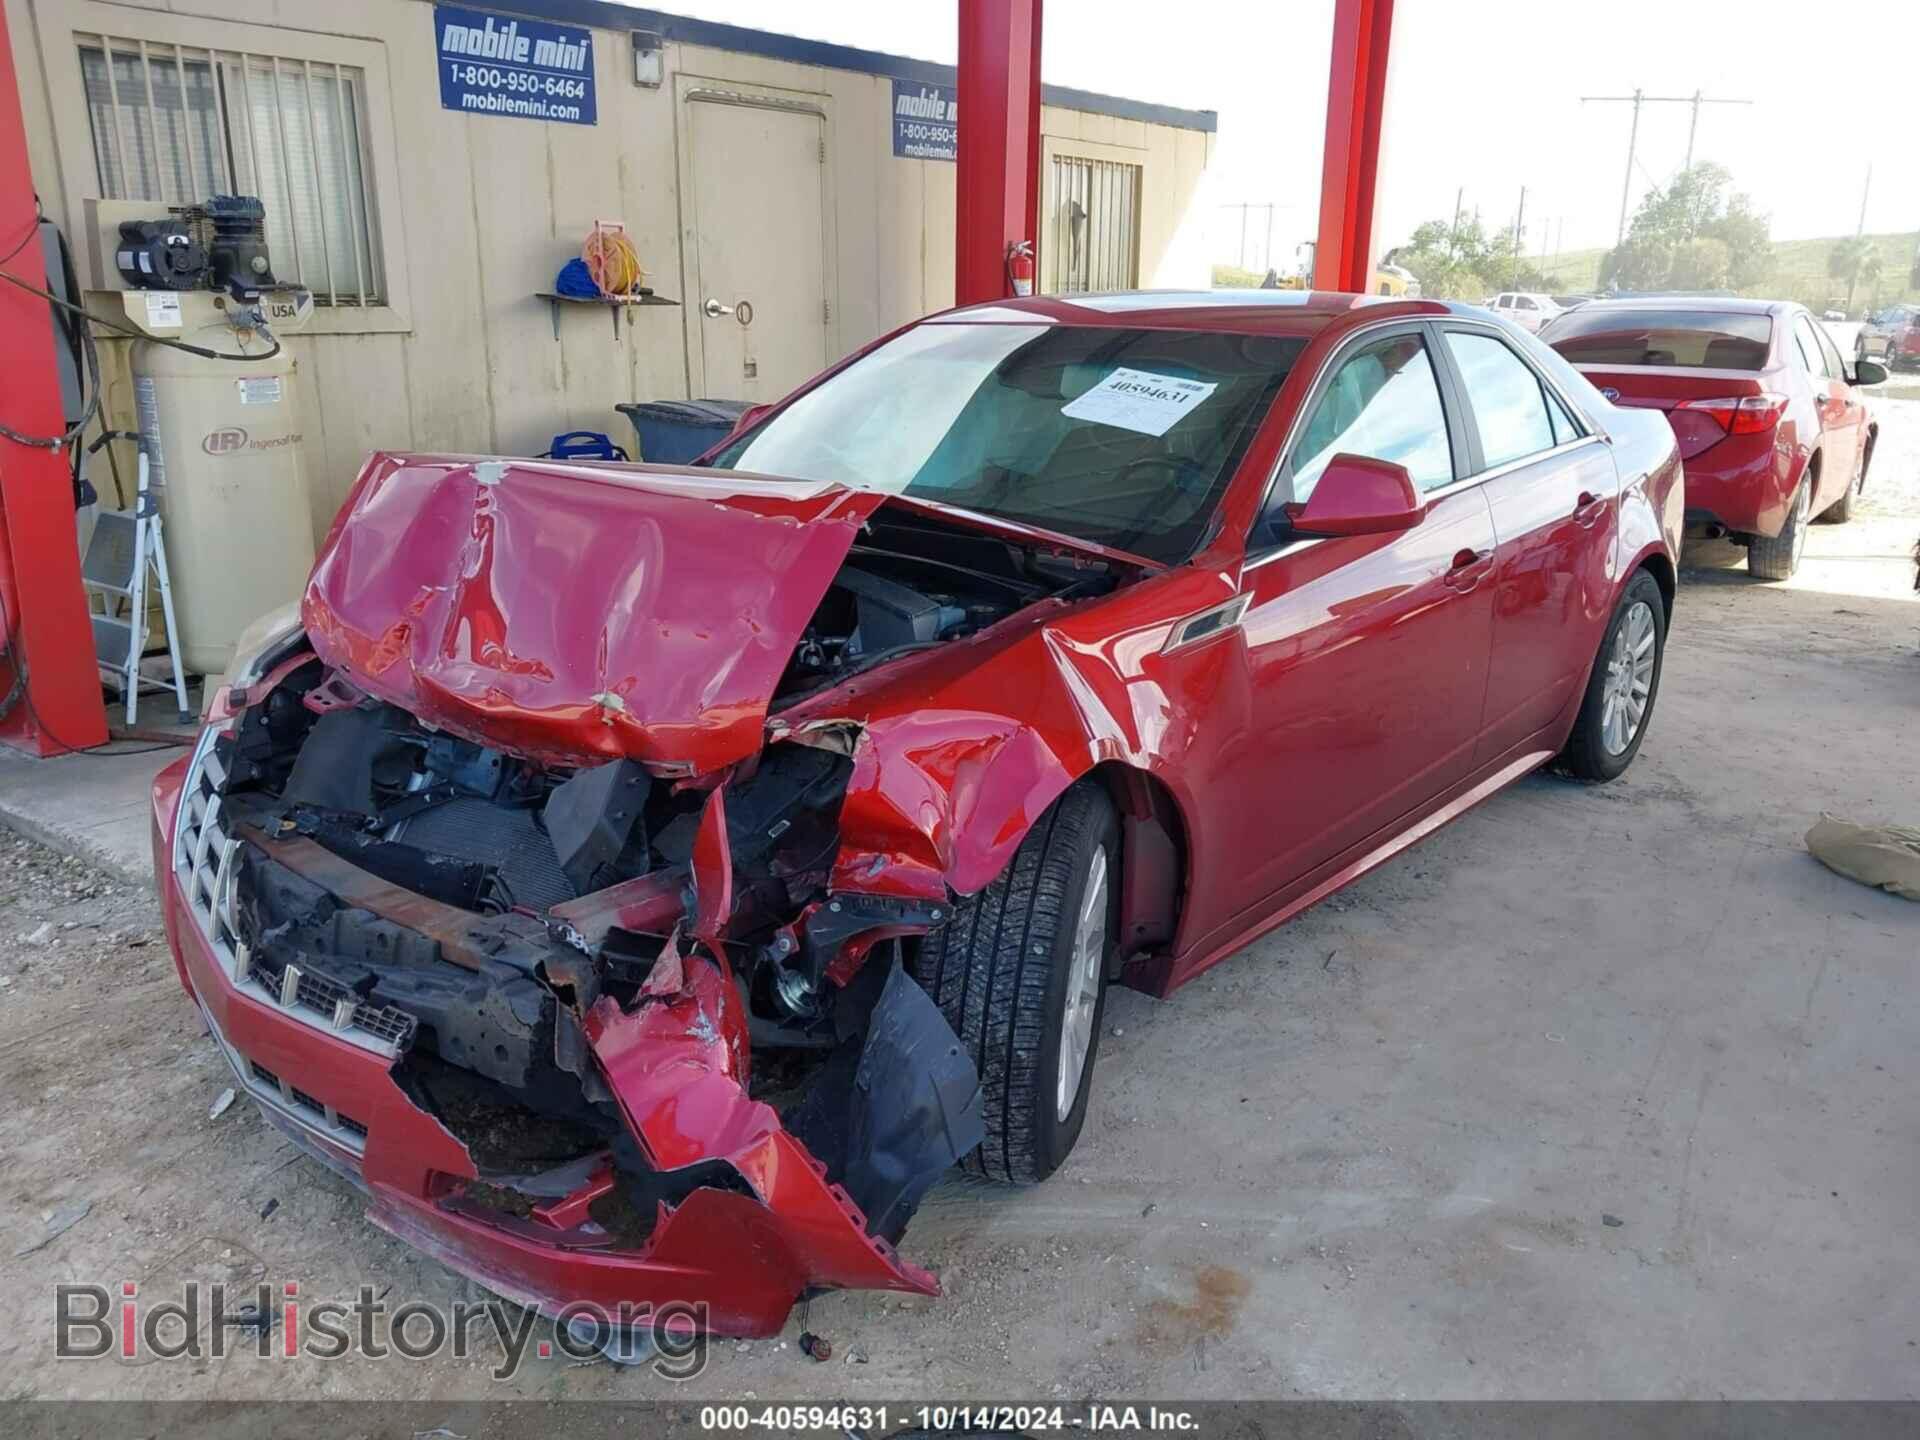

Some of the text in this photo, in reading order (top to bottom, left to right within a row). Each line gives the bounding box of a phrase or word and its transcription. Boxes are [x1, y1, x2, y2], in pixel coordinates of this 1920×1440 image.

[442, 17, 587, 71] mobile mini
[451, 64, 585, 99] 1-800-950-6464
[462, 92, 580, 120] mobilemini.com
[896, 87, 946, 120] mobile
[272, 305, 297, 318] USA
[1108, 381, 1191, 404] 40594631
